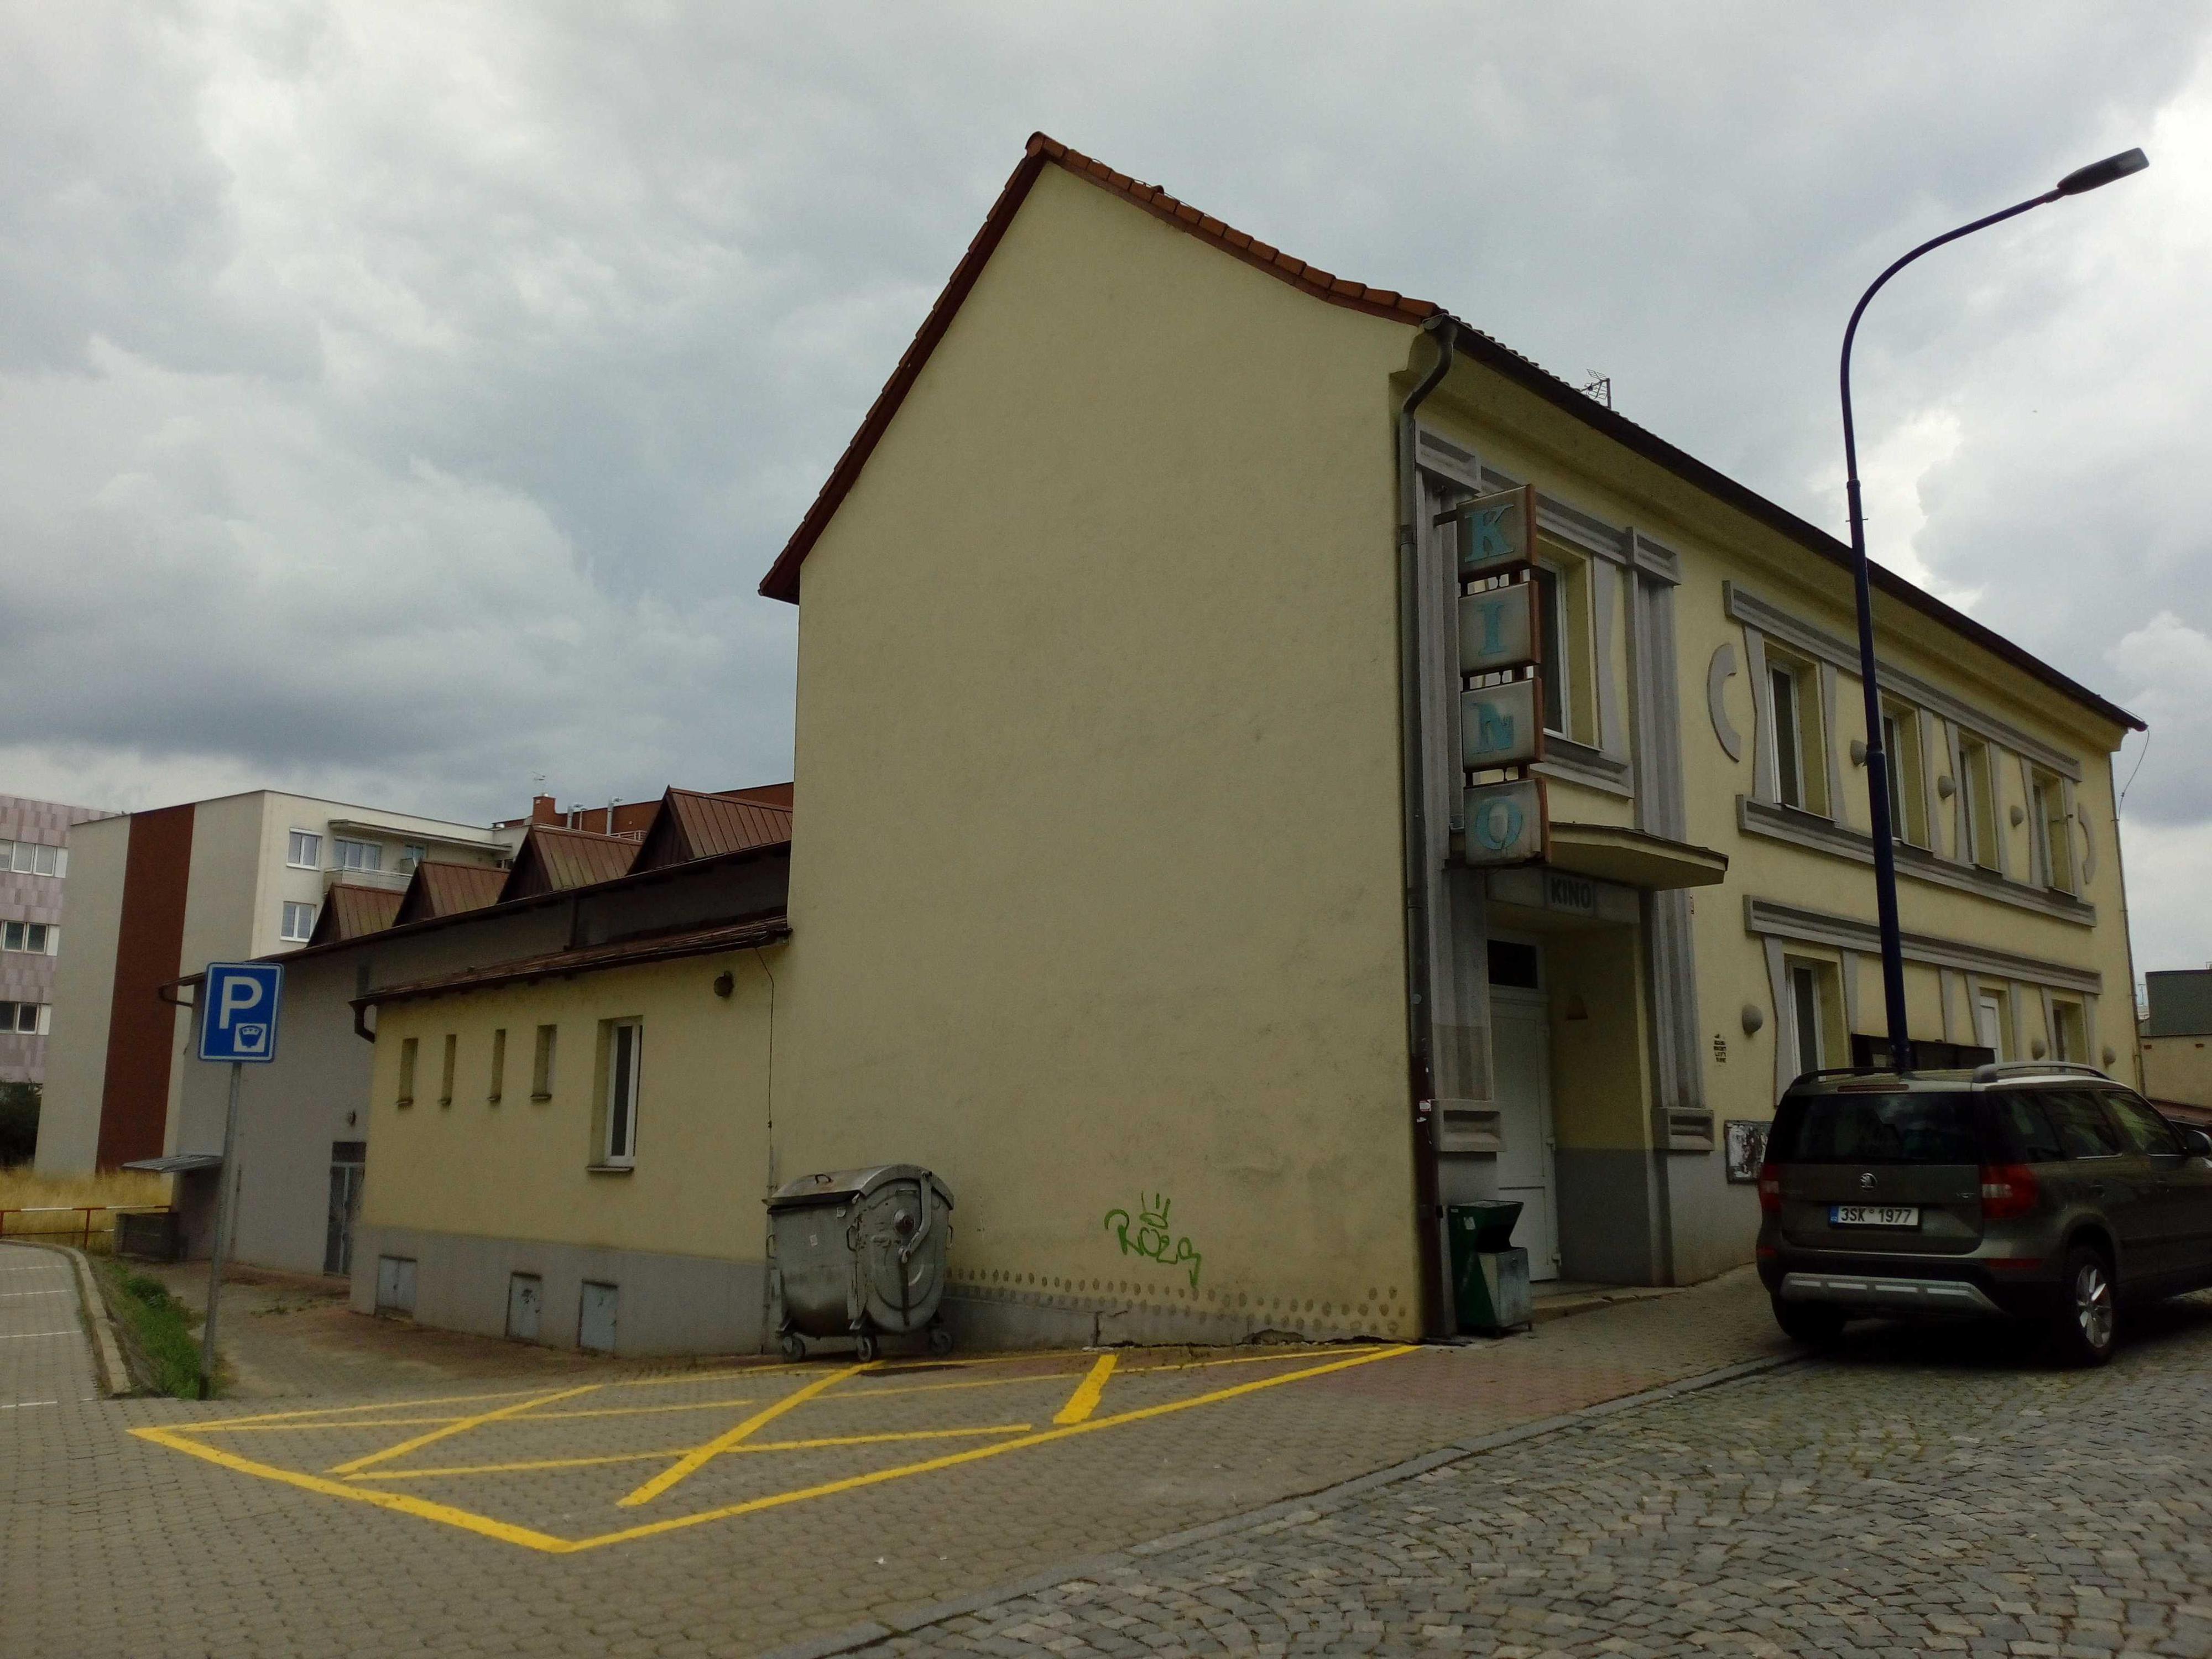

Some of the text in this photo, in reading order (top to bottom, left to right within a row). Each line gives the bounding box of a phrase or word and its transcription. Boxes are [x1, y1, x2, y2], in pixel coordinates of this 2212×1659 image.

[1464, 504, 1523, 851] KINO
[1551, 877, 1592, 909] KINO
[219, 976, 263, 1029] P
[1841, 1207, 1912, 1223] 3SK 1977
